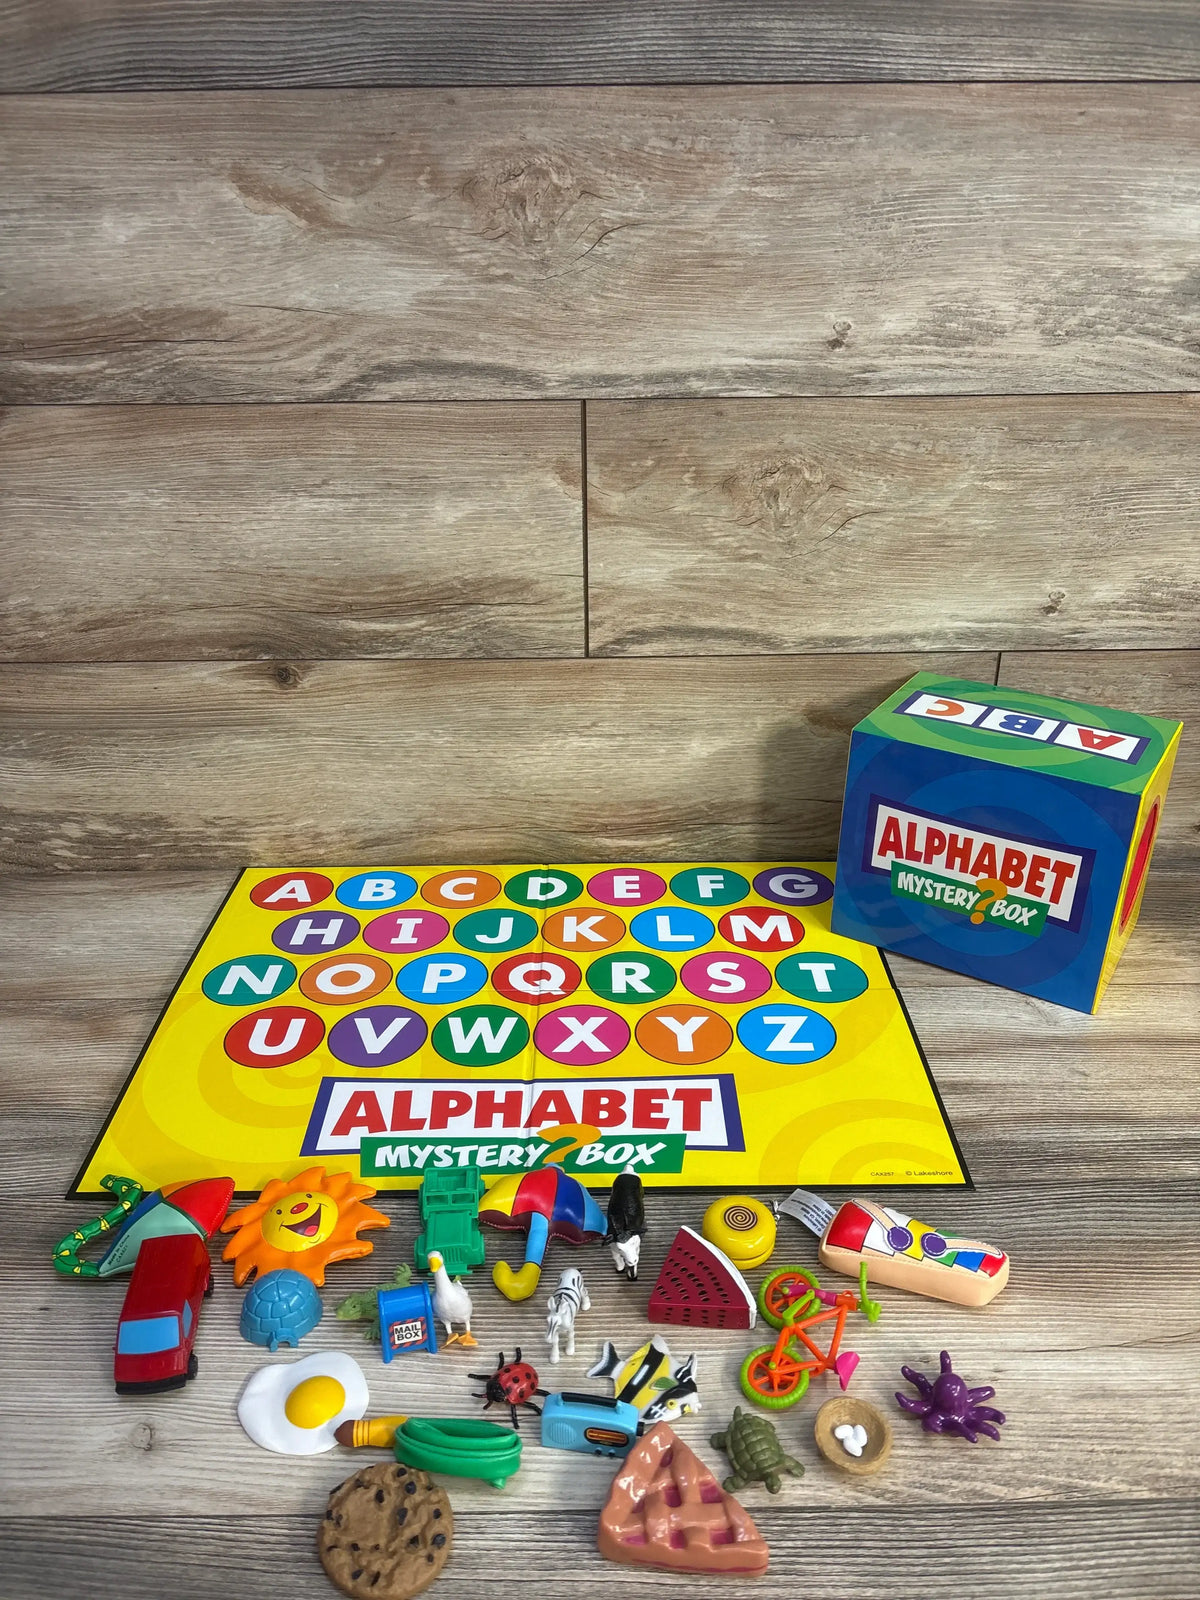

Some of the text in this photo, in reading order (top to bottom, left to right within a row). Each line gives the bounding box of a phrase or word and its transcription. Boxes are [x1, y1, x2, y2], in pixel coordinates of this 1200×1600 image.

[925, 700, 1127, 751] A B C
[877, 816, 1076, 905] ALPHABET
[263, 873, 818, 903] A B C D E F G
[897, 871, 981, 911] MYSTERY
[990, 899, 1038, 927] BOX
[289, 915, 794, 946] H I J K L M
[217, 961, 836, 996] N O P Q R S T
[248, 1015, 815, 1056] U V W X Y Z
[330, 1088, 713, 1136] ALPHABET
[374, 1143, 551, 1168] MYSTERY
[575, 1142, 667, 1166] BOX
[395, 1324, 420, 1334] MAIL
[397, 1331, 419, 1341] BOX
